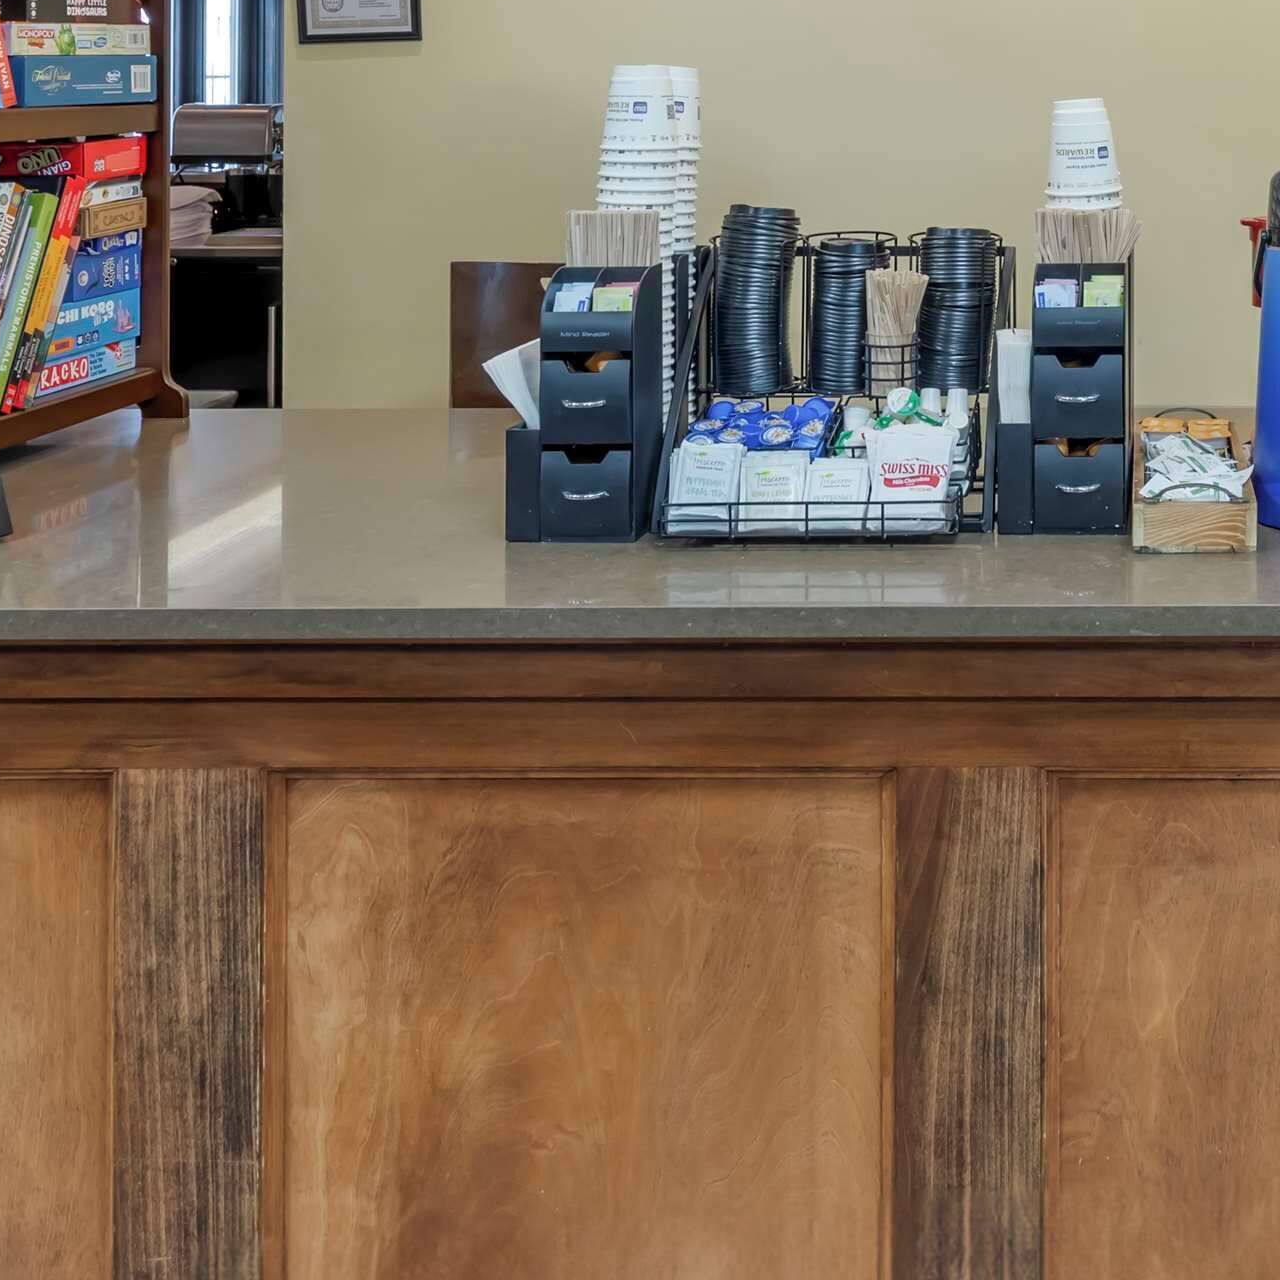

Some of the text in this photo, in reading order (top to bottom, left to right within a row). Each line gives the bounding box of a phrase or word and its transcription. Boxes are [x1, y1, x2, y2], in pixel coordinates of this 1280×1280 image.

[66, 6, 108, 16] DINOSAURS
[19, 30, 54, 38] MONOPOLY
[19, 147, 61, 174] UNO
[15, 242, 43, 313] PREHISTORIC
[81, 301, 114, 318] KORO
[0, 316, 20, 372] MAMMALS
[880, 463, 916, 477] SWISS
